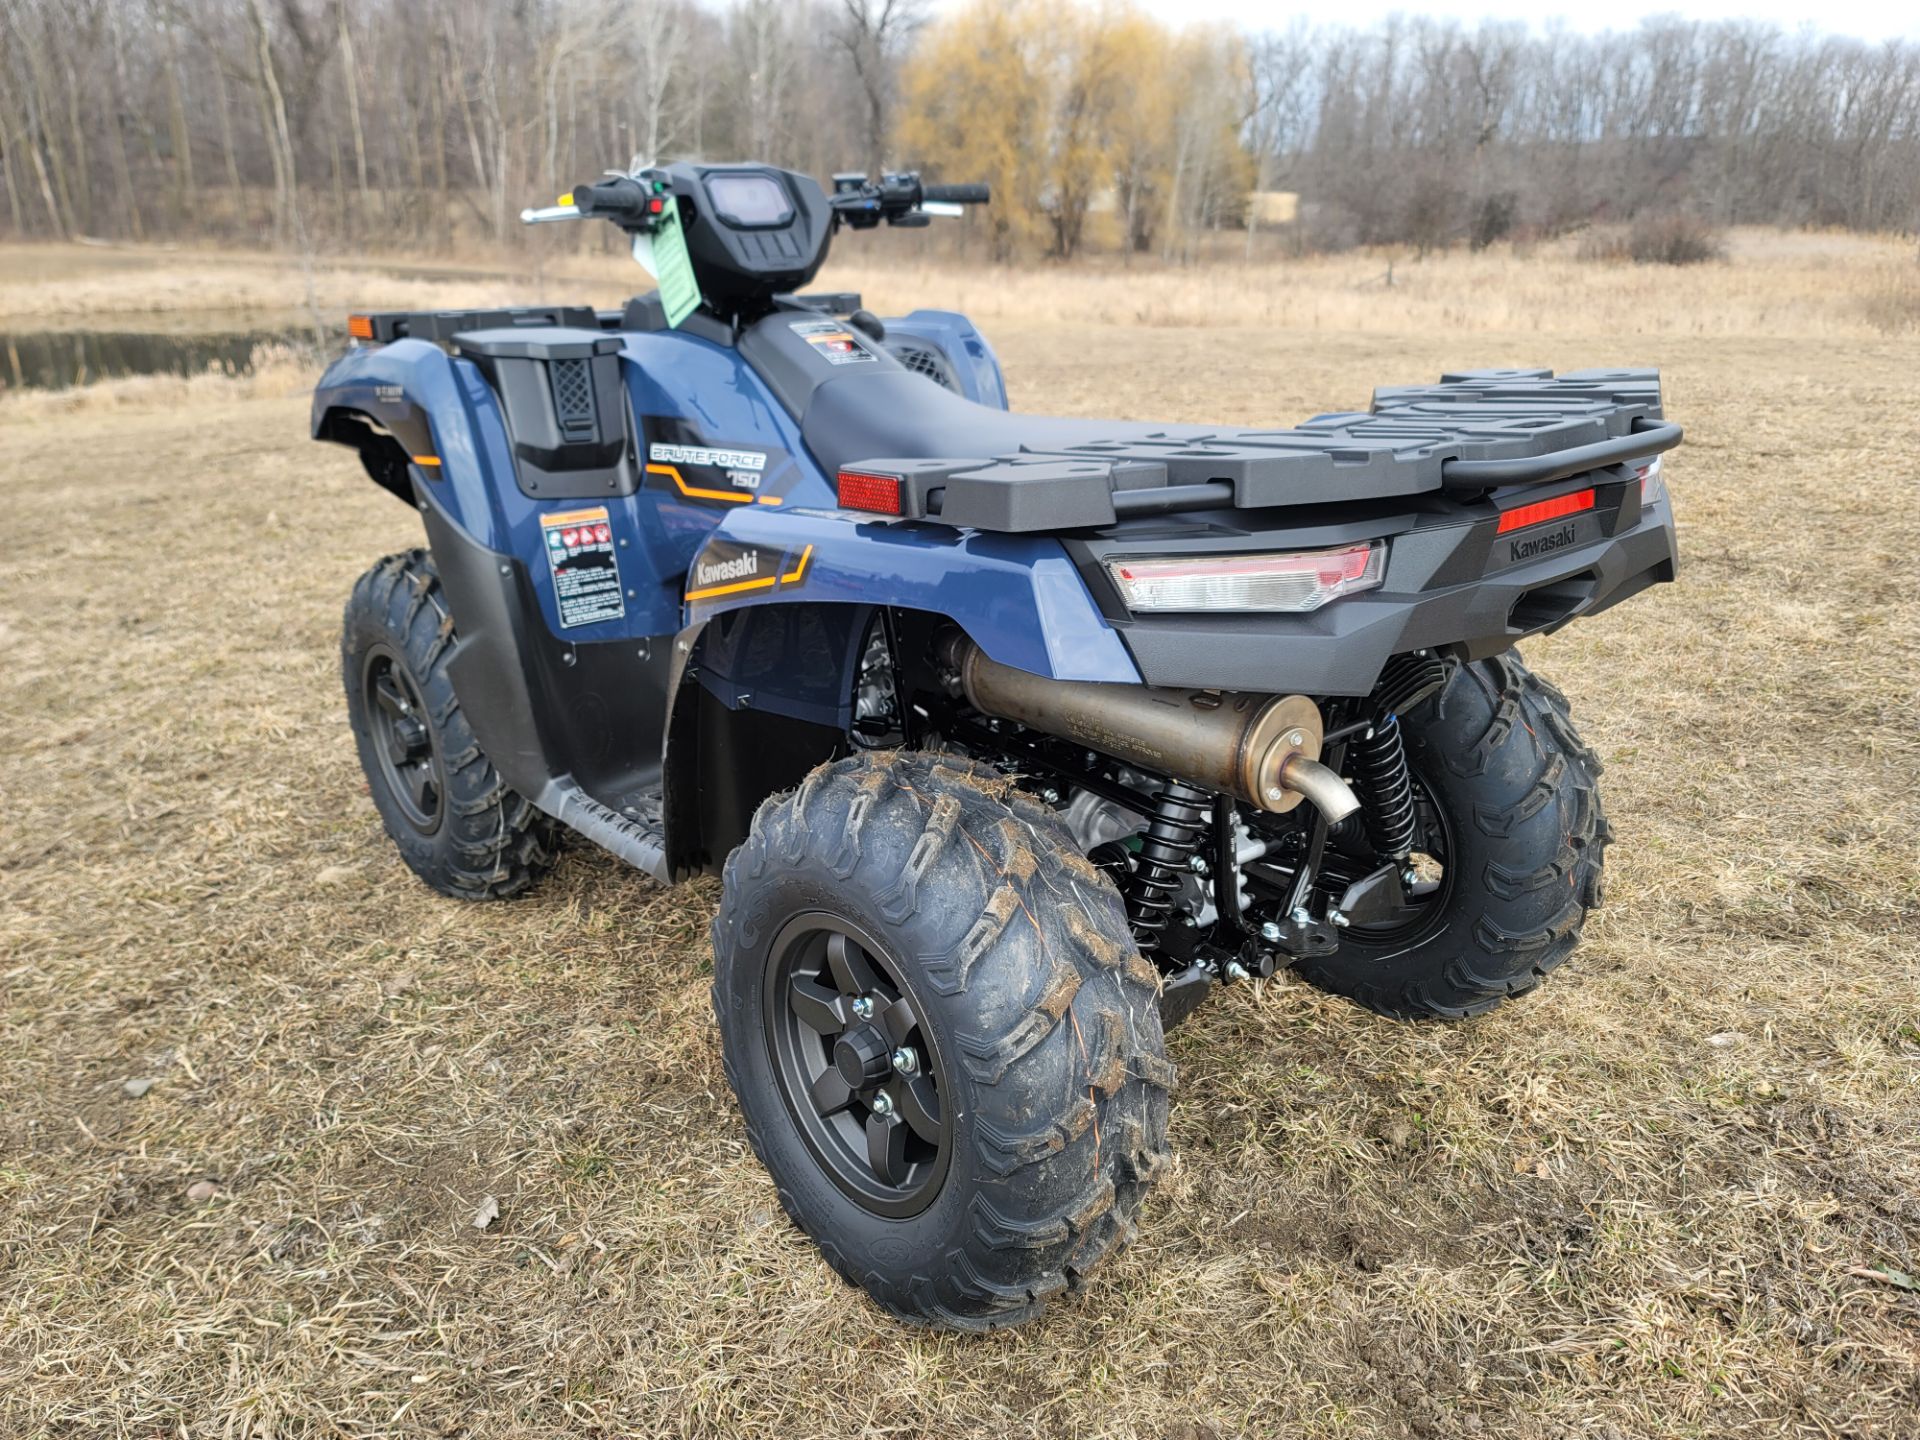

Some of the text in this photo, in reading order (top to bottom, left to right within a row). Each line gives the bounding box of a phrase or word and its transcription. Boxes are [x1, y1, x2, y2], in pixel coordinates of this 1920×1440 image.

[727, 471, 761, 487] 750
[1511, 525, 1575, 561] Kawasaki
[697, 551, 757, 585] Kawasaki
